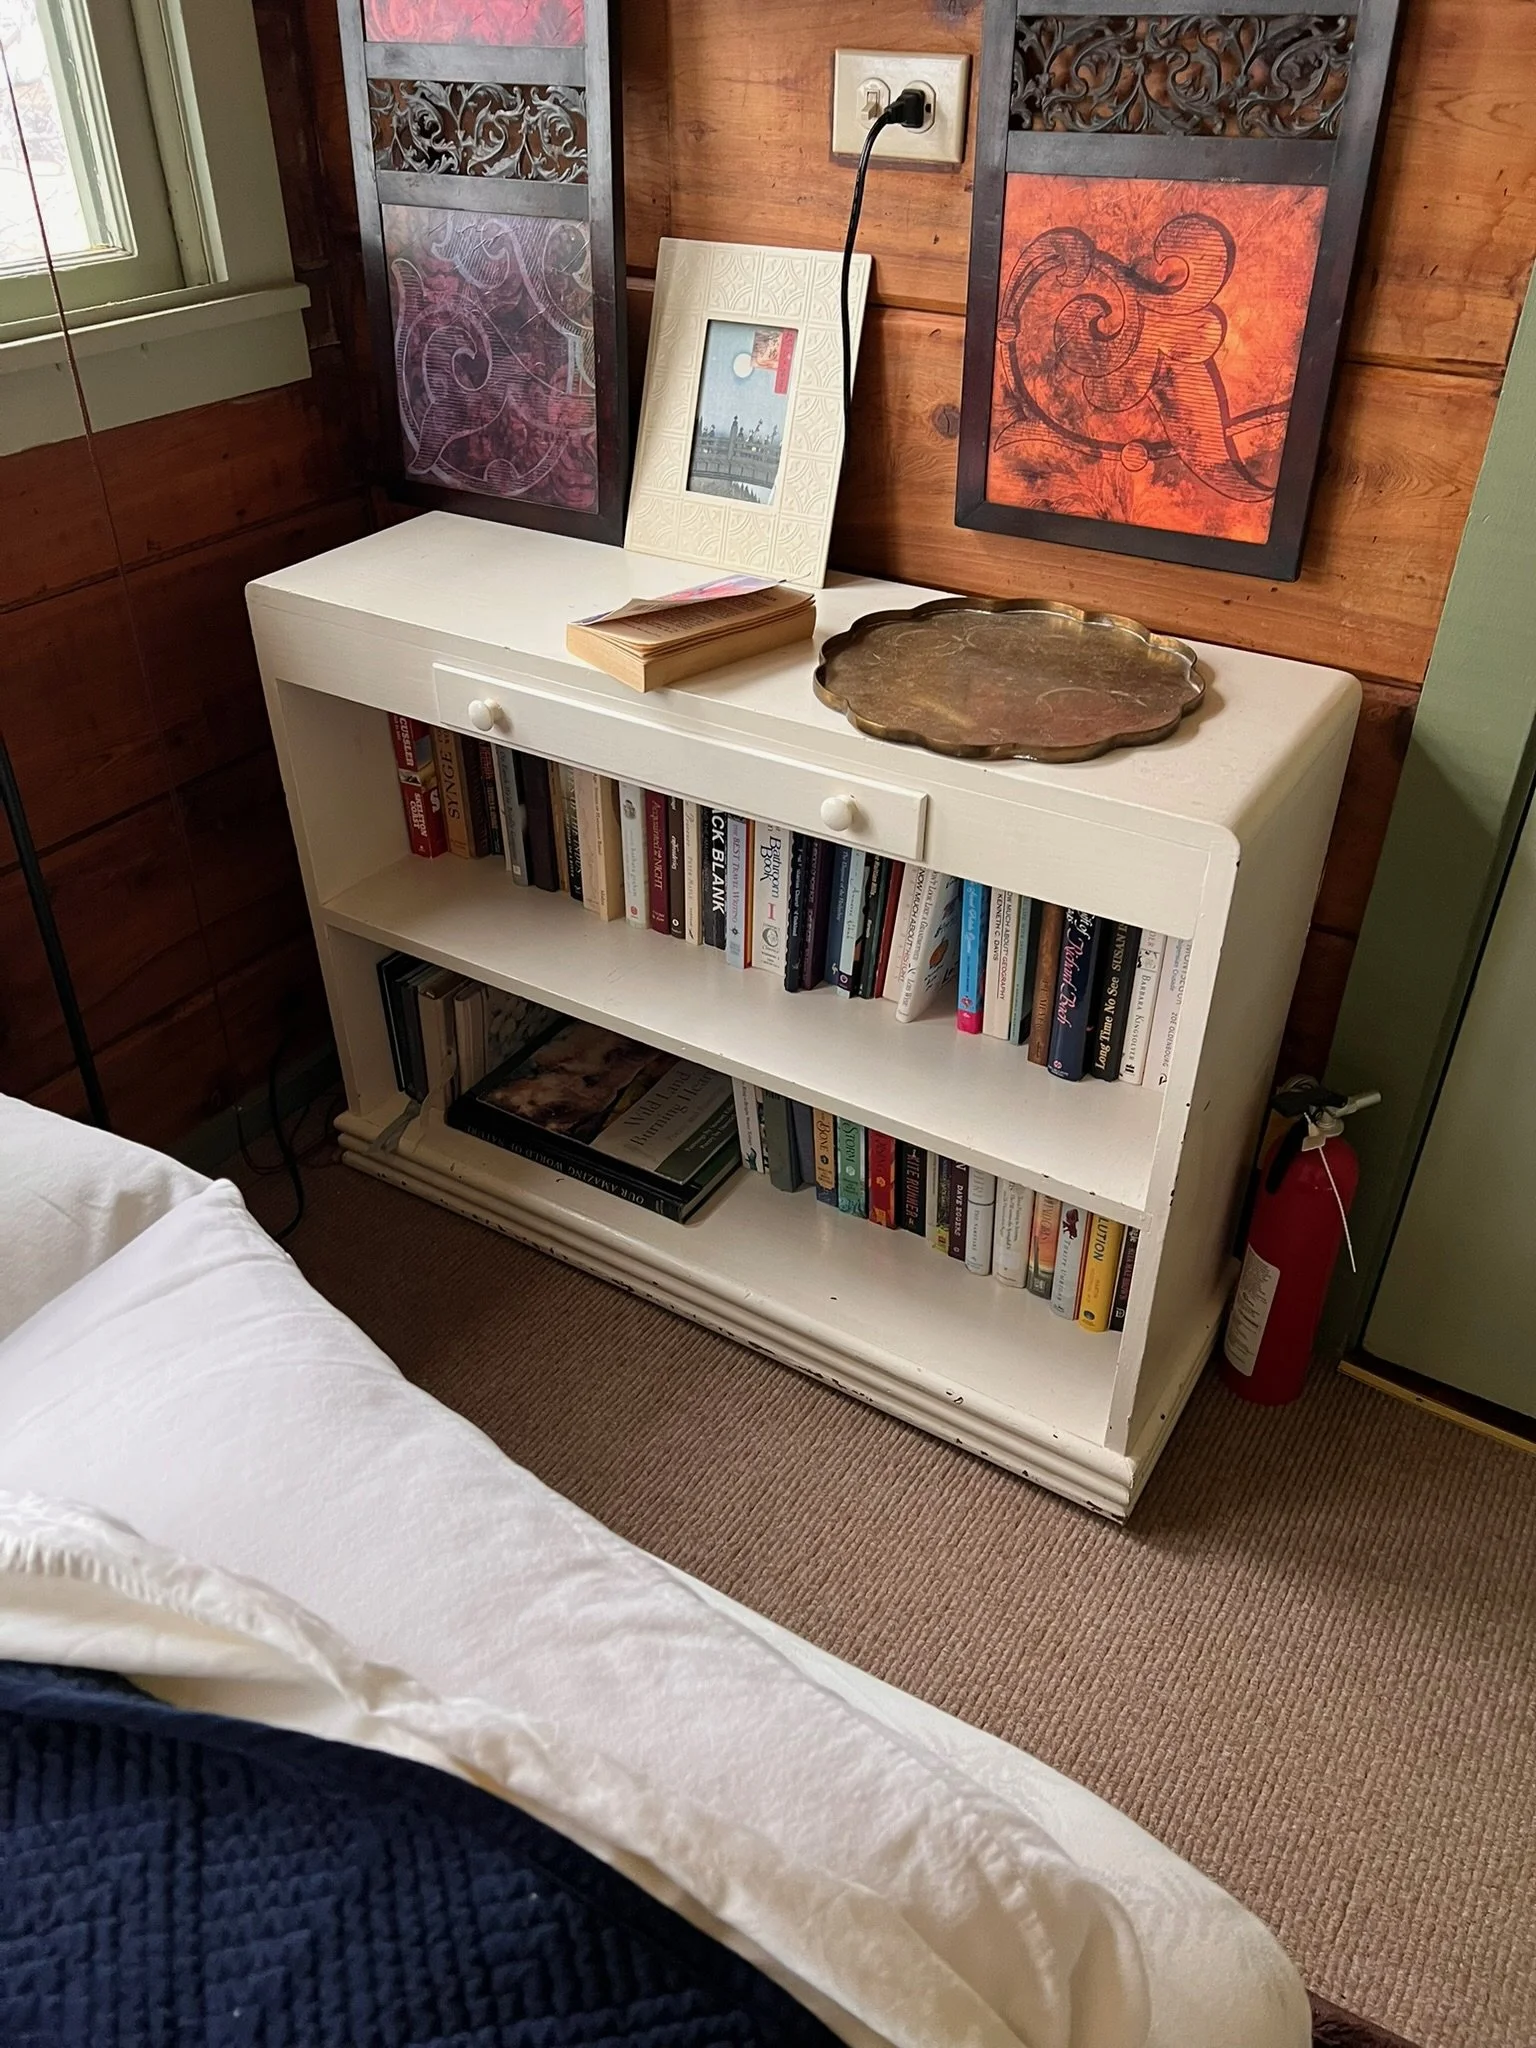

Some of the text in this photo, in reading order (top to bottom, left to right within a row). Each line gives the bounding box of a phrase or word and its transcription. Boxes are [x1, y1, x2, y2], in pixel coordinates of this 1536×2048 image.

[400, 717, 414, 767] CUSSLER
[410, 800, 420, 830] COAST
[414, 793, 428, 837] SKELETON
[654, 858, 663, 891] NIGHT
[711, 847, 725, 915] BLANK
[732, 863, 740, 889] TRAVEL
[759, 845, 774, 882] Book
[769, 836, 782, 898] Bathroom
[911, 891, 922, 918] MUCH
[995, 893, 1004, 930] KENNETH
[1004, 904, 1012, 927] MUCH
[992, 939, 1000, 961] DAVIS
[1060, 928, 1084, 996] Richard
[1111, 933, 1127, 971] SUSAN
[999, 956, 1009, 1001] GEOGRAPHY
[1107, 976, 1120, 997] See
[1056, 993, 1078, 1038] Bach
[1102, 999, 1116, 1012] No
[1100, 1016, 1113, 1042] Time
[1161, 1025, 1177, 1067] OLDENBOURG
[1094, 1043, 1106, 1071] Long
[624, 1100, 662, 1125] Wild
[656, 1070, 691, 1100] Land
[630, 1104, 689, 1146] Burning
[816, 1120, 831, 1152] BONE
[842, 1123, 860, 1162] STORM
[568, 1166, 617, 1198] AMAZING
[620, 1189, 645, 1205] OUR
[905, 1154, 920, 1219] KITE RUNNER
[953, 1184, 964, 1237] DAVE EGGERS
[1093, 1218, 1109, 1262] LUTION
